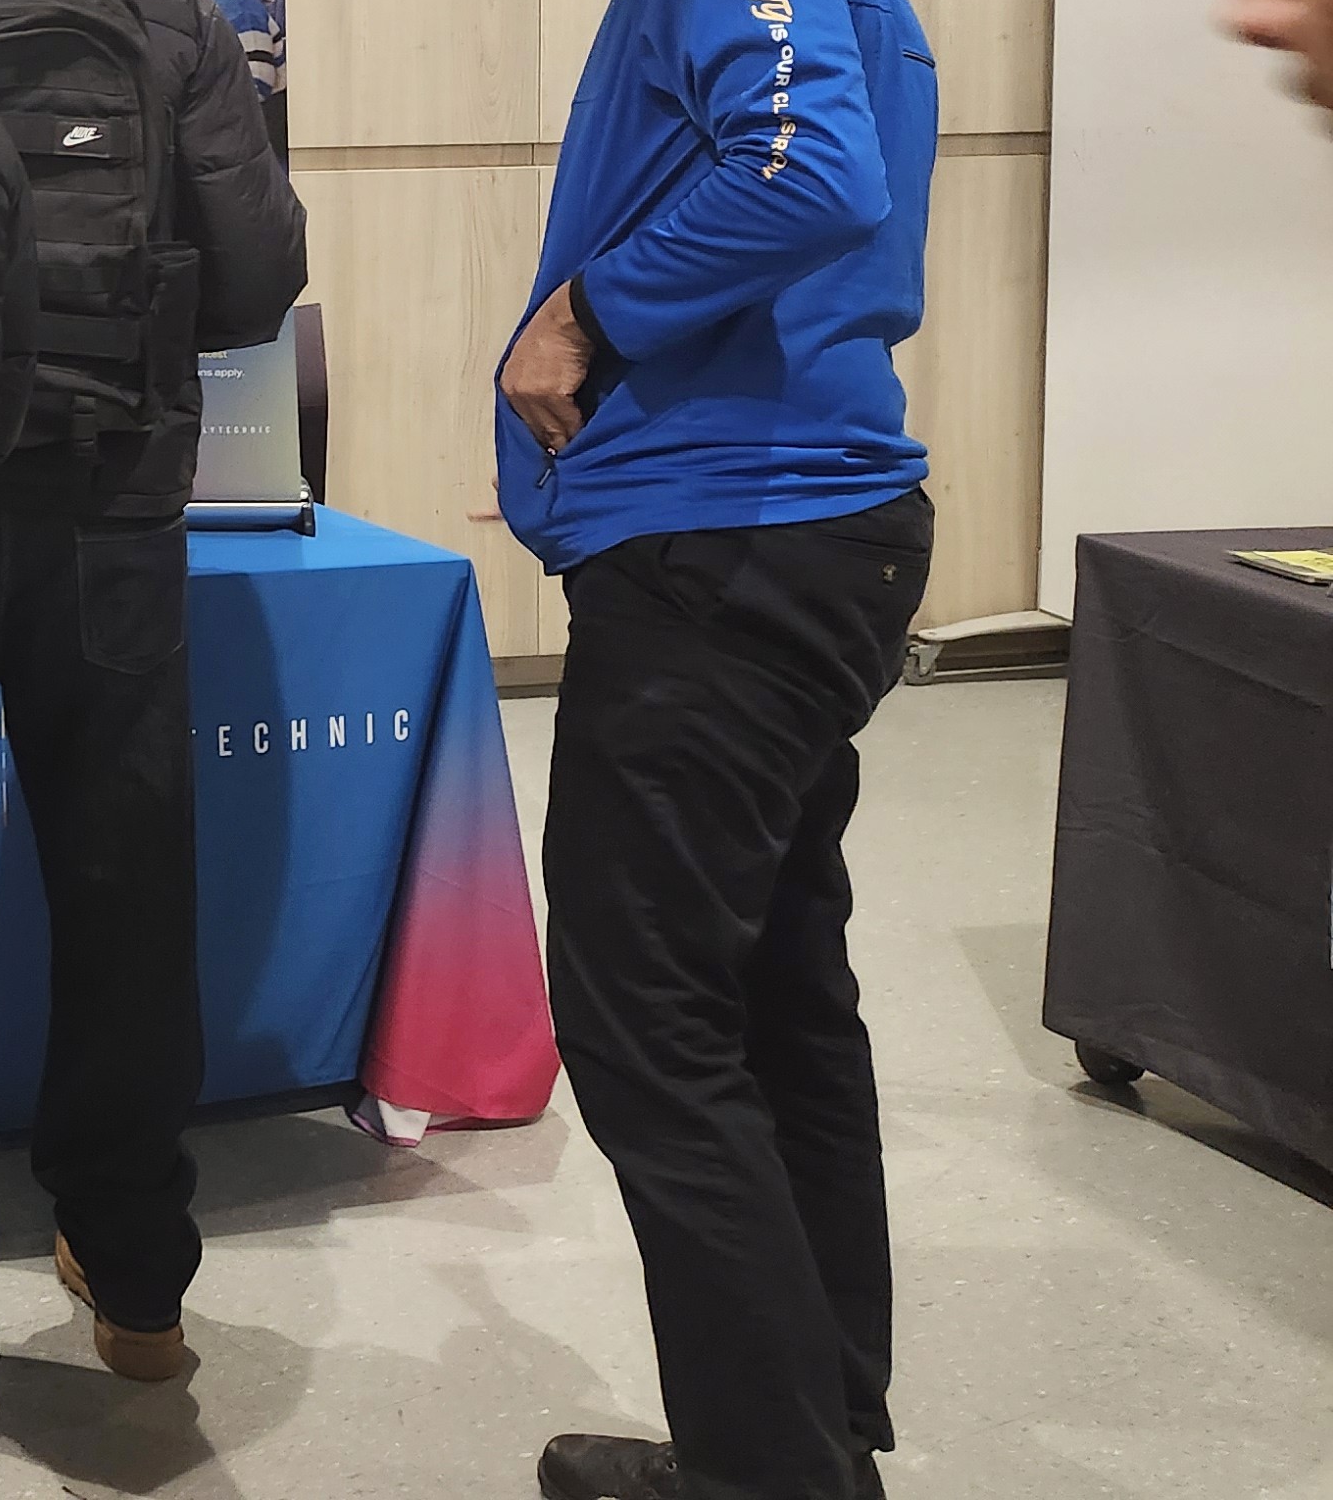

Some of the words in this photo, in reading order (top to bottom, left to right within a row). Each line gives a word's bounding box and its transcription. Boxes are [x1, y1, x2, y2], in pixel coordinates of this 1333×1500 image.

[768, 24, 788, 42] IS
[774, 45, 795, 87] OUR
[191, 709, 409, 757] ECHNIC
